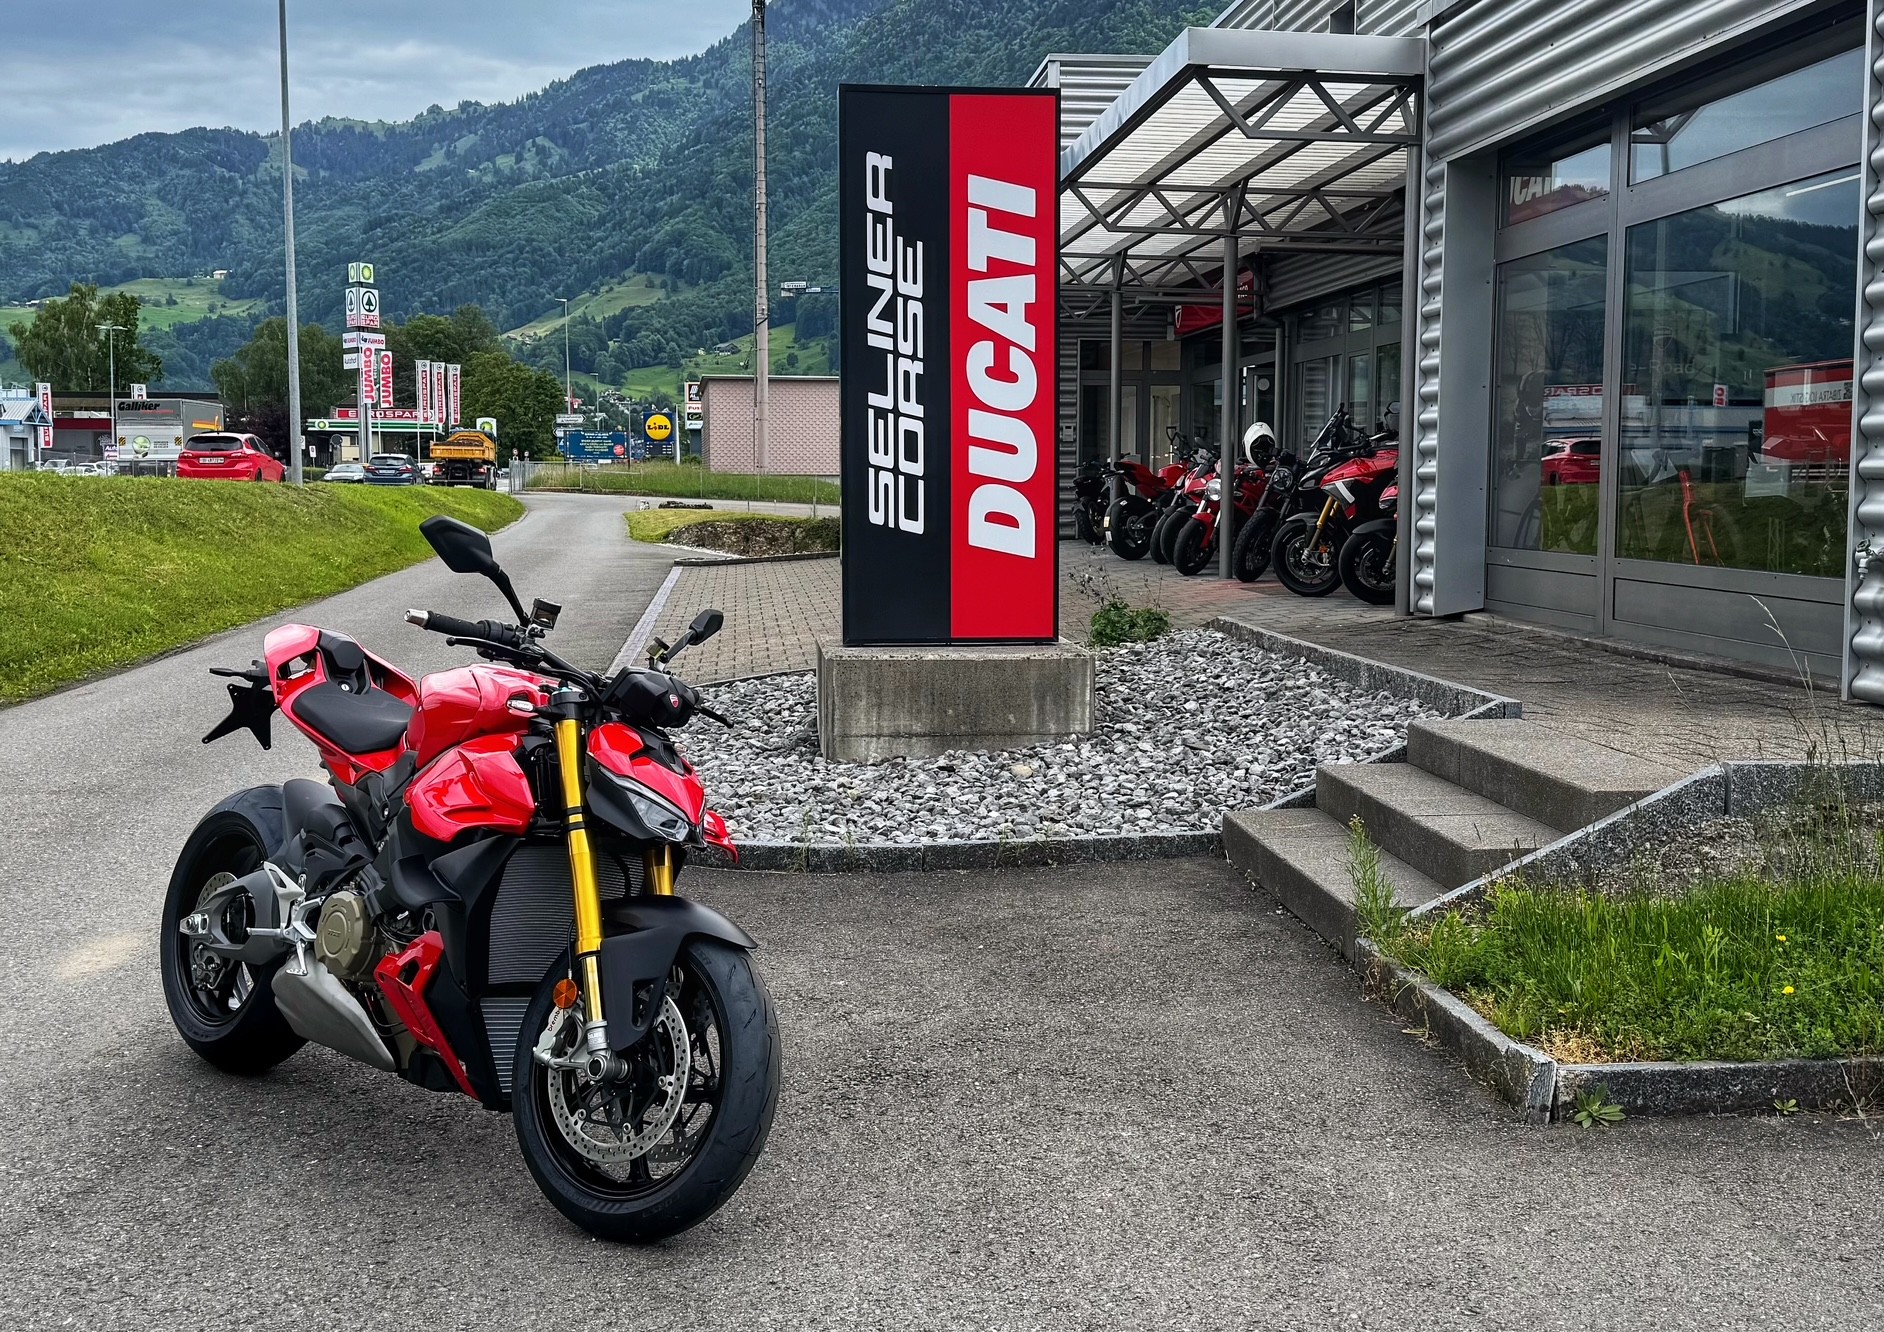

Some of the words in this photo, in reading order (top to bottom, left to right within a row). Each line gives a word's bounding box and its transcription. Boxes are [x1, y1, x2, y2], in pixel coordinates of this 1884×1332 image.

[866, 150, 894, 529] SELINER
[967, 173, 1038, 559] DUCATI
[363, 347, 375, 402] JUMBO
[380, 353, 392, 407] JUMBO
[897, 236, 925, 535] CORSE
[118, 401, 160, 411] Galliker
[348, 409, 420, 418] EROSPAR
